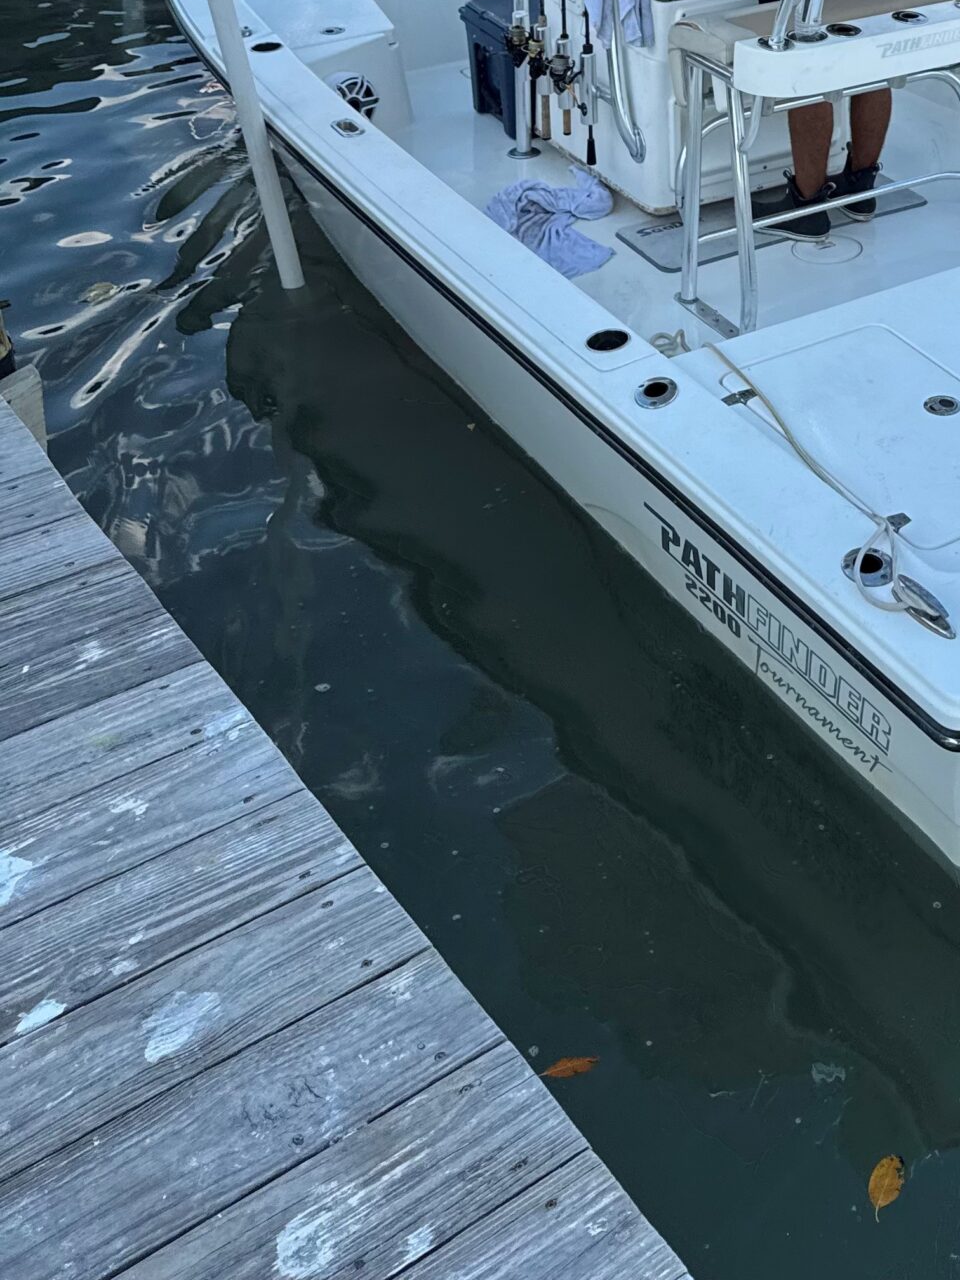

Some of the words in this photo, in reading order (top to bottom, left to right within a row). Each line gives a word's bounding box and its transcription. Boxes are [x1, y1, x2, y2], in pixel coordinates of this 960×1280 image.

[644, 502, 892, 754] PATHFINDER
[685, 574, 742, 639] 2200
[748, 634, 893, 772] Tournament
